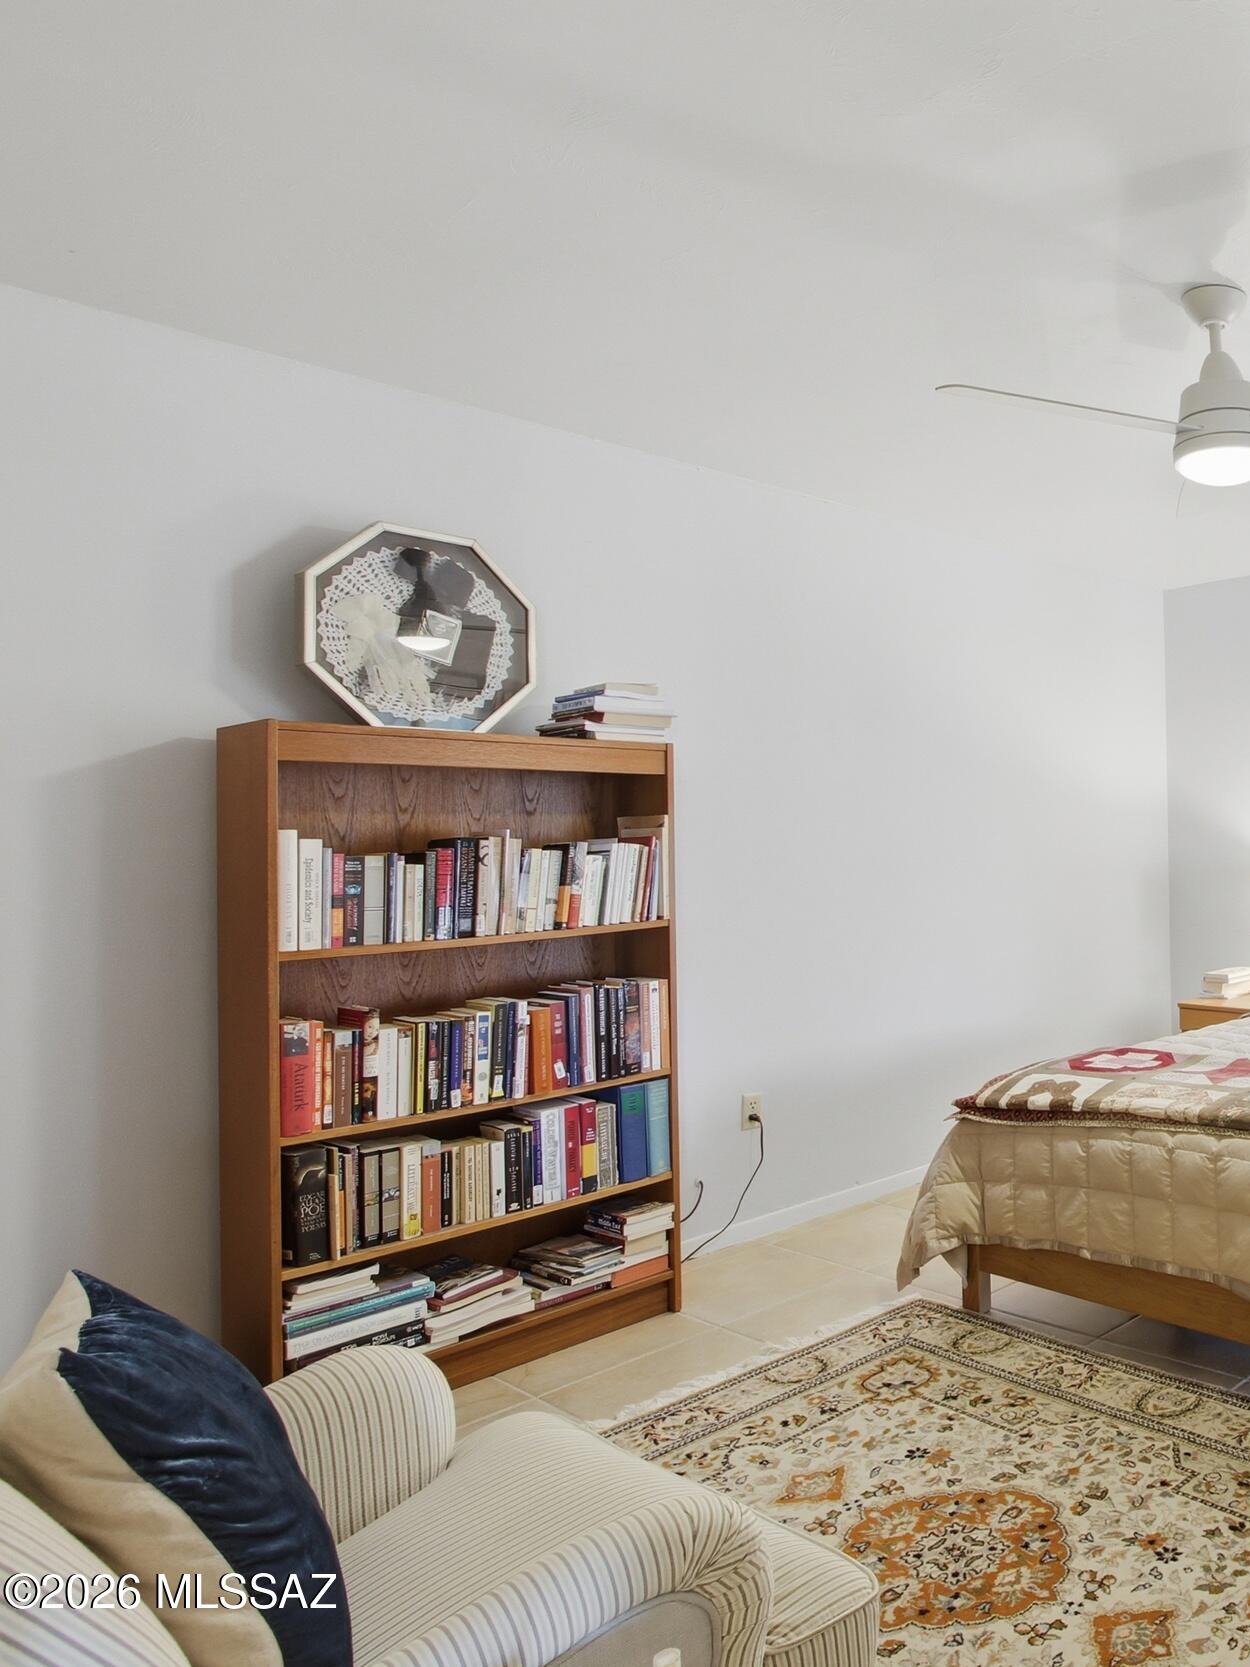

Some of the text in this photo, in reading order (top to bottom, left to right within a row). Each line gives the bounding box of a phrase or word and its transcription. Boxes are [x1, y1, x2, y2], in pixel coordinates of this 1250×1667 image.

[302, 857, 314, 888] Epidemics
[304, 889, 314, 901] and
[303, 902, 314, 923] Society
